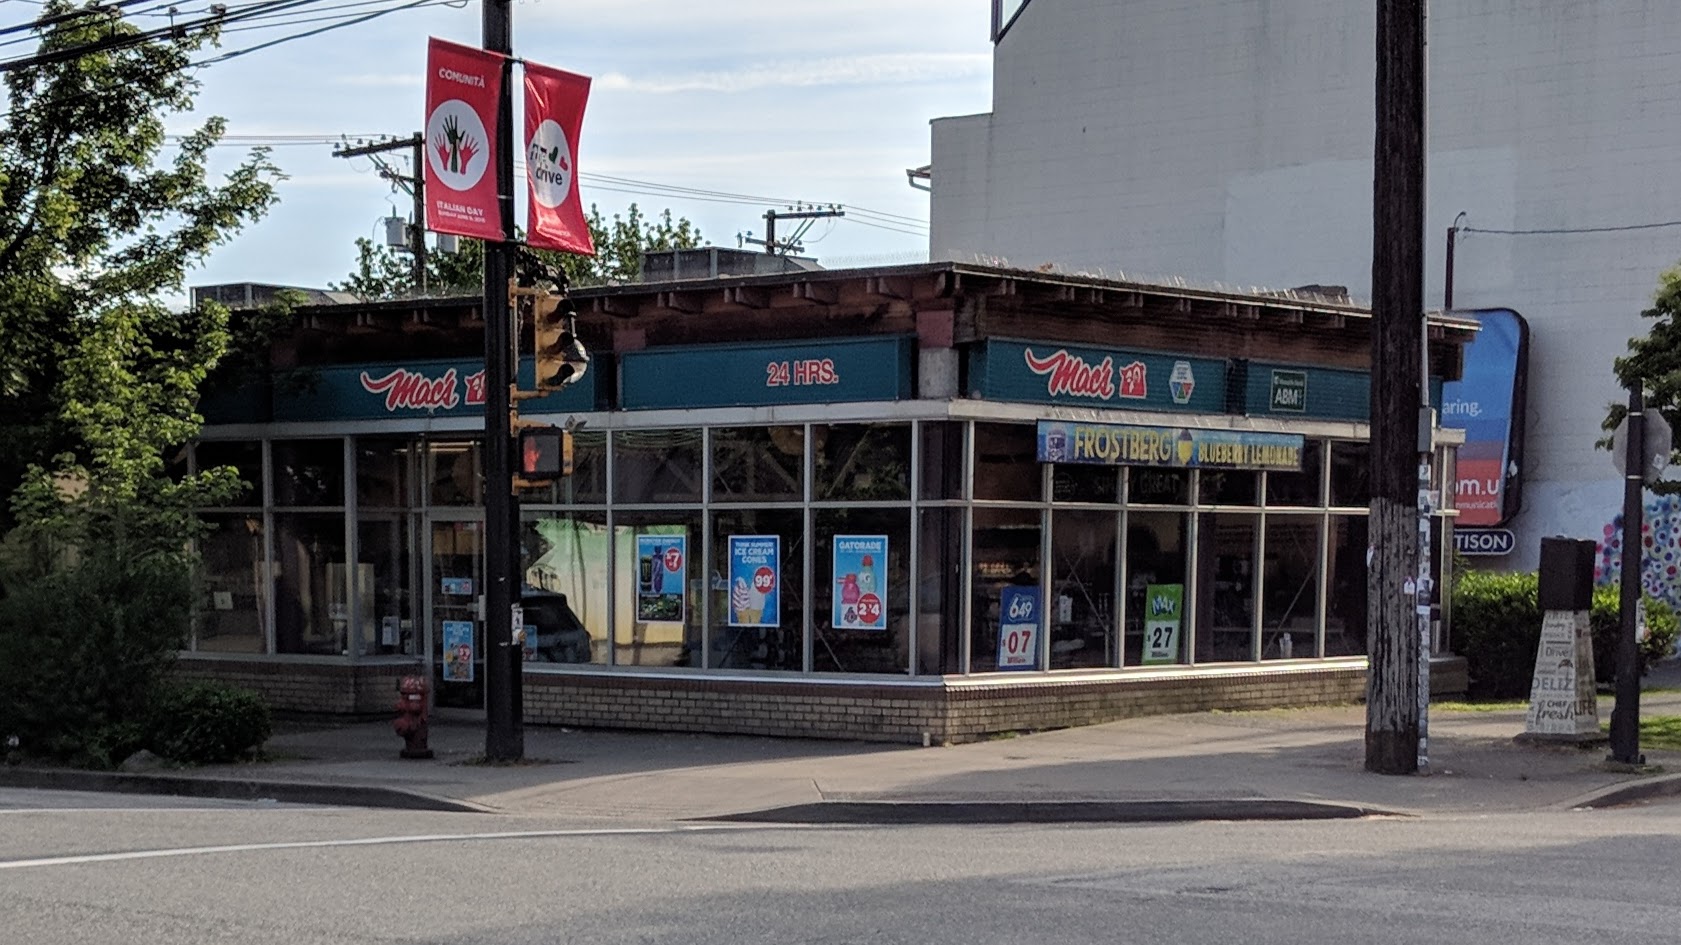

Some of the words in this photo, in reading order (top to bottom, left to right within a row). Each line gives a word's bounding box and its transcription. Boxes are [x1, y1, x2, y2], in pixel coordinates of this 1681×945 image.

[535, 165, 563, 185] drive
[436, 200, 465, 213] ITALIAN
[466, 206, 484, 217] DAY
[766, 361, 790, 387] 24
[793, 358, 840, 386] HRS.
[1024, 347, 1115, 400] Mac's
[360, 368, 459, 411] Mac's
[1274, 387, 1299, 406] ABM
[1072, 426, 1171, 462] FROSTBERG
[1198, 441, 1249, 464] BLUEBERRY
[1250, 444, 1300, 467] LEMONADE
[734, 547, 747, 556] ICE
[747, 547, 774, 556] CREAM
[838, 541, 883, 550] GATORADE
[1454, 534, 1508, 550] TISON
[741, 556, 767, 564] CONES
[1535, 700, 1575, 725] fresh
